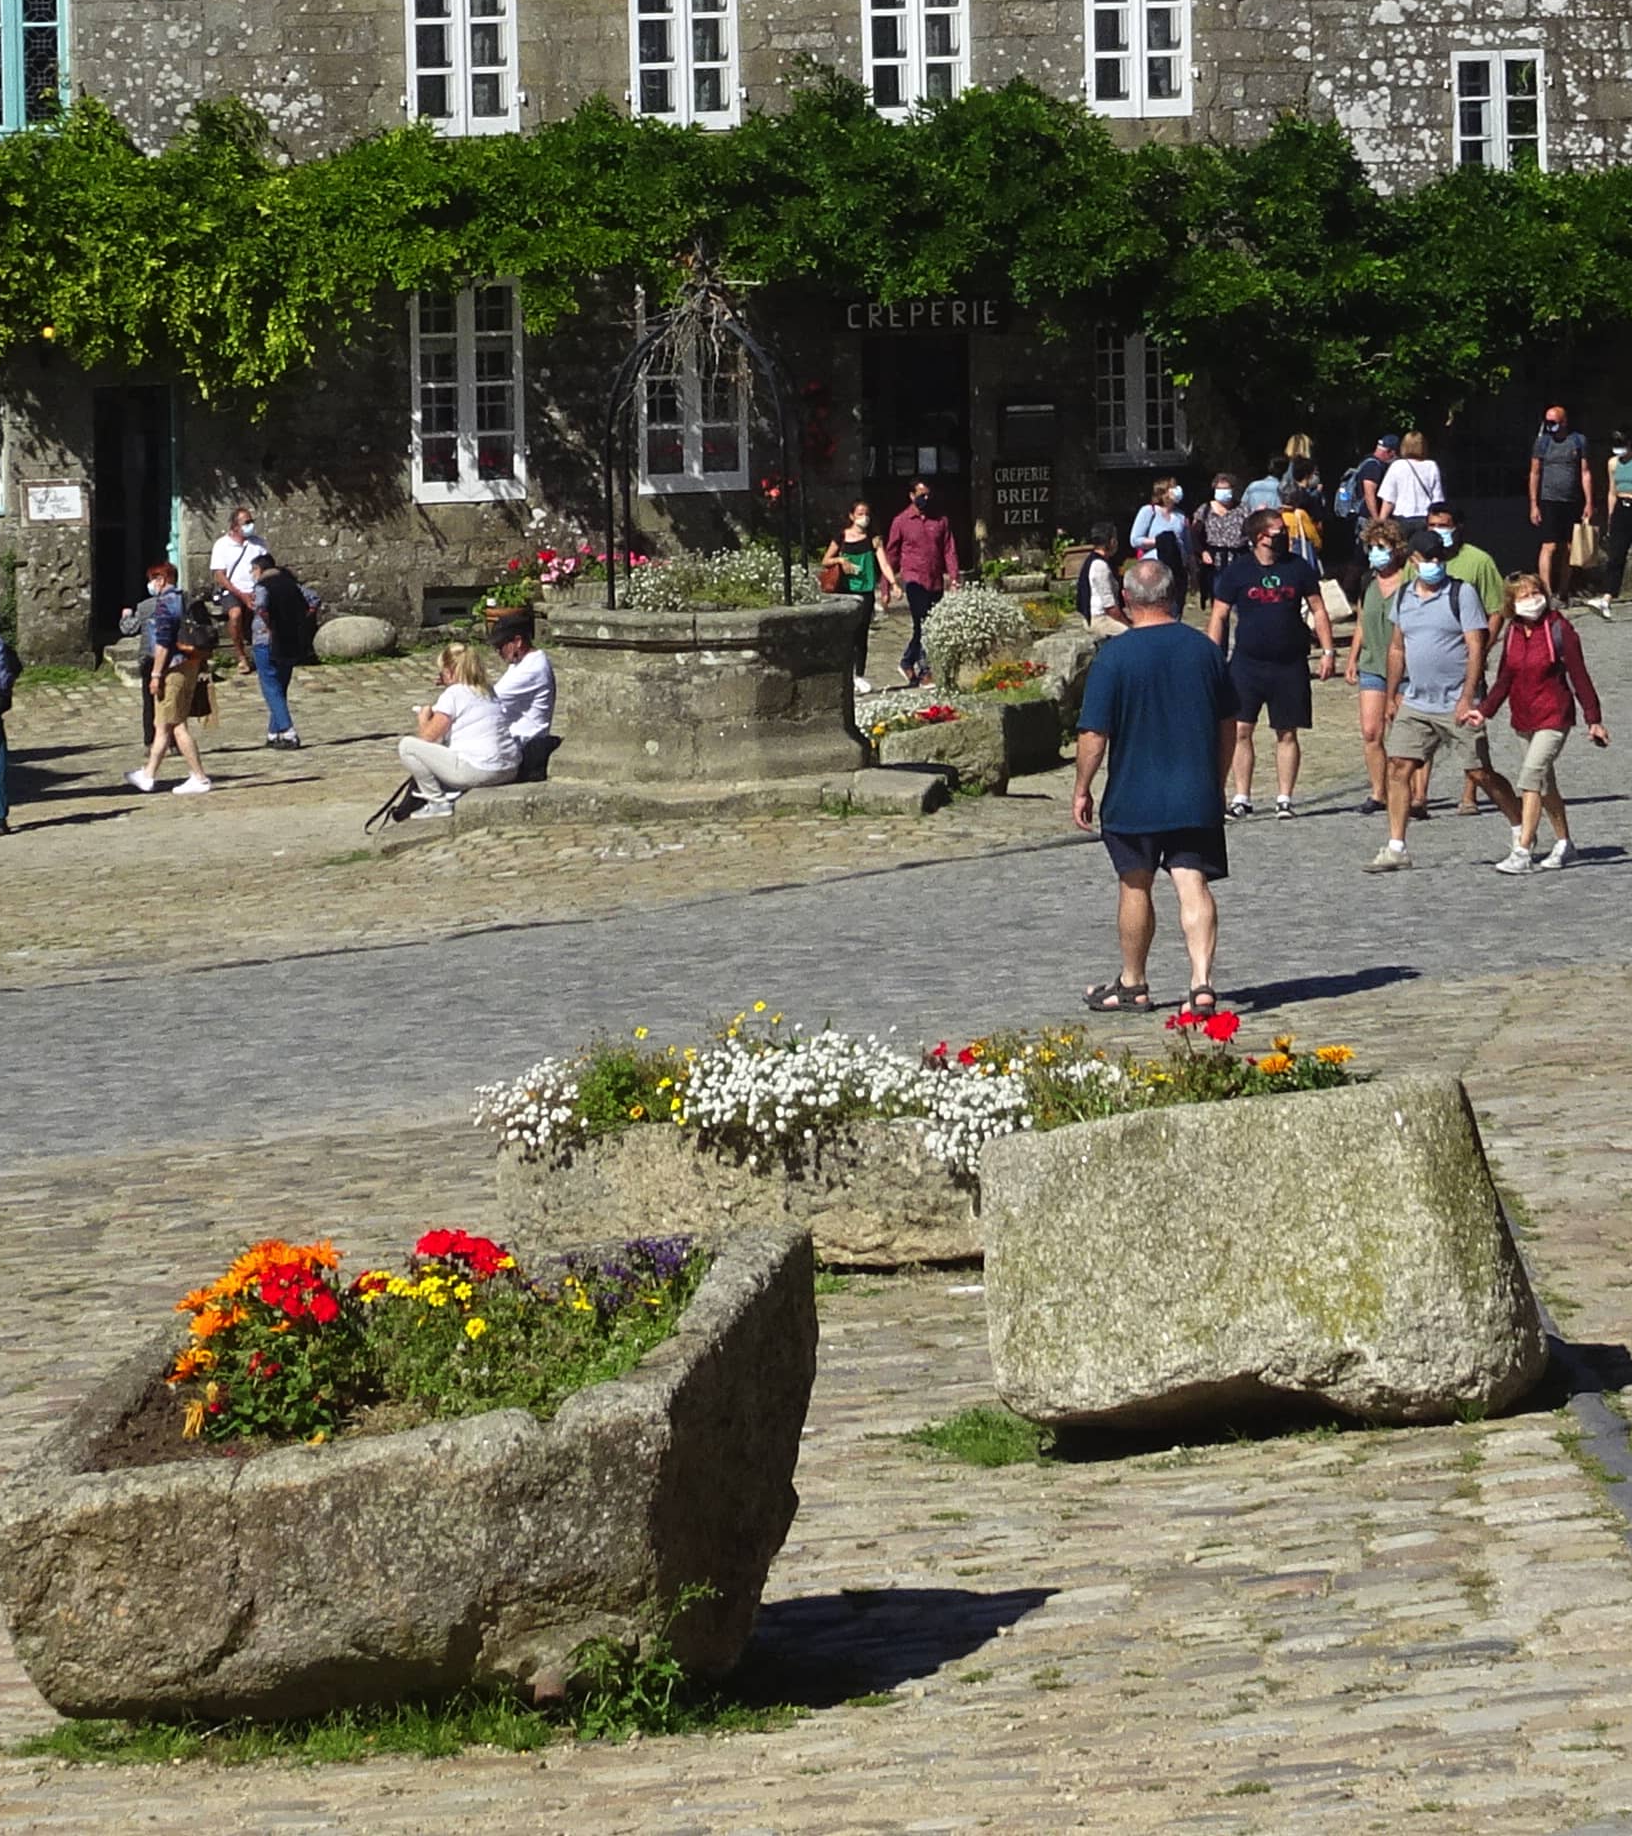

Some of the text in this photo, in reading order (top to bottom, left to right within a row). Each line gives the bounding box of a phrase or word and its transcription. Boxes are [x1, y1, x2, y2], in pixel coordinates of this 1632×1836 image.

[847, 299, 999, 329] CREPERIE
[994, 465, 1051, 484] CREPERIE
[996, 486, 1049, 505] BREIZ
[1003, 507, 1045, 525] IZEL
